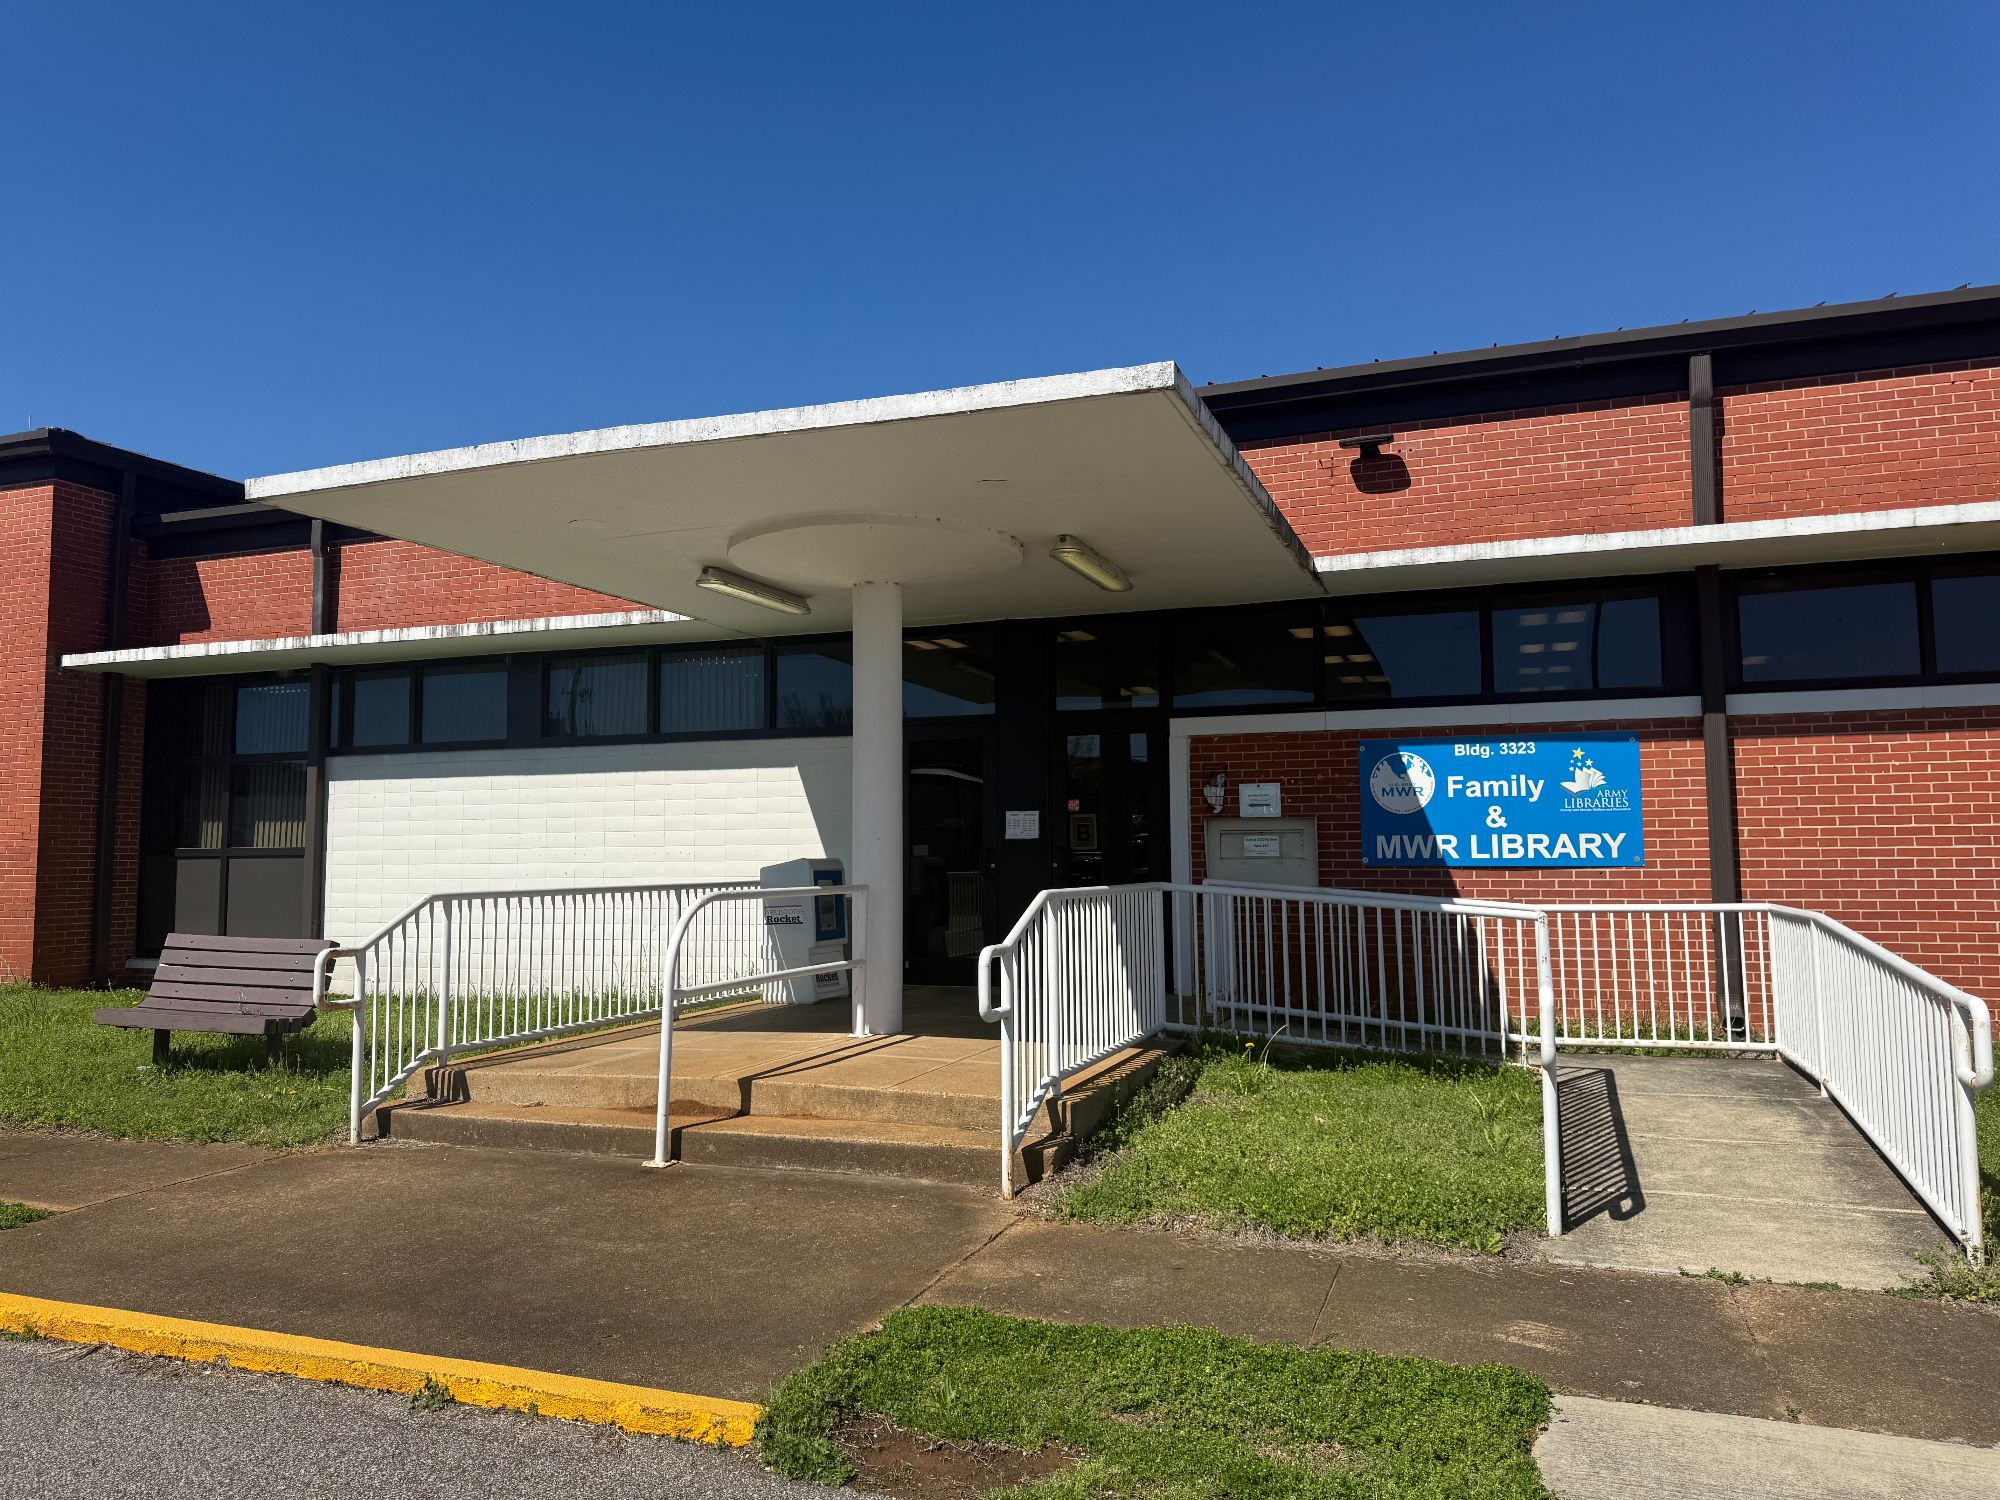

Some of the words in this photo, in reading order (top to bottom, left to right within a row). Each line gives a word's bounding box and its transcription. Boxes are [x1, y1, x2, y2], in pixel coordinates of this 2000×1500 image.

[1454, 743, 1494, 758] Bldg.
[1499, 742, 1536, 755] 3323
[1381, 786, 1424, 797] MWR
[1447, 774, 1545, 802] Family
[1597, 789, 1628, 799] ARMY
[1564, 797, 1629, 809] LIBRARIES
[1485, 805, 1508, 828] &
[1376, 834, 1460, 859] MWR
[1470, 832, 1627, 859] LIBRARY
[766, 915, 801, 923] Rocket
